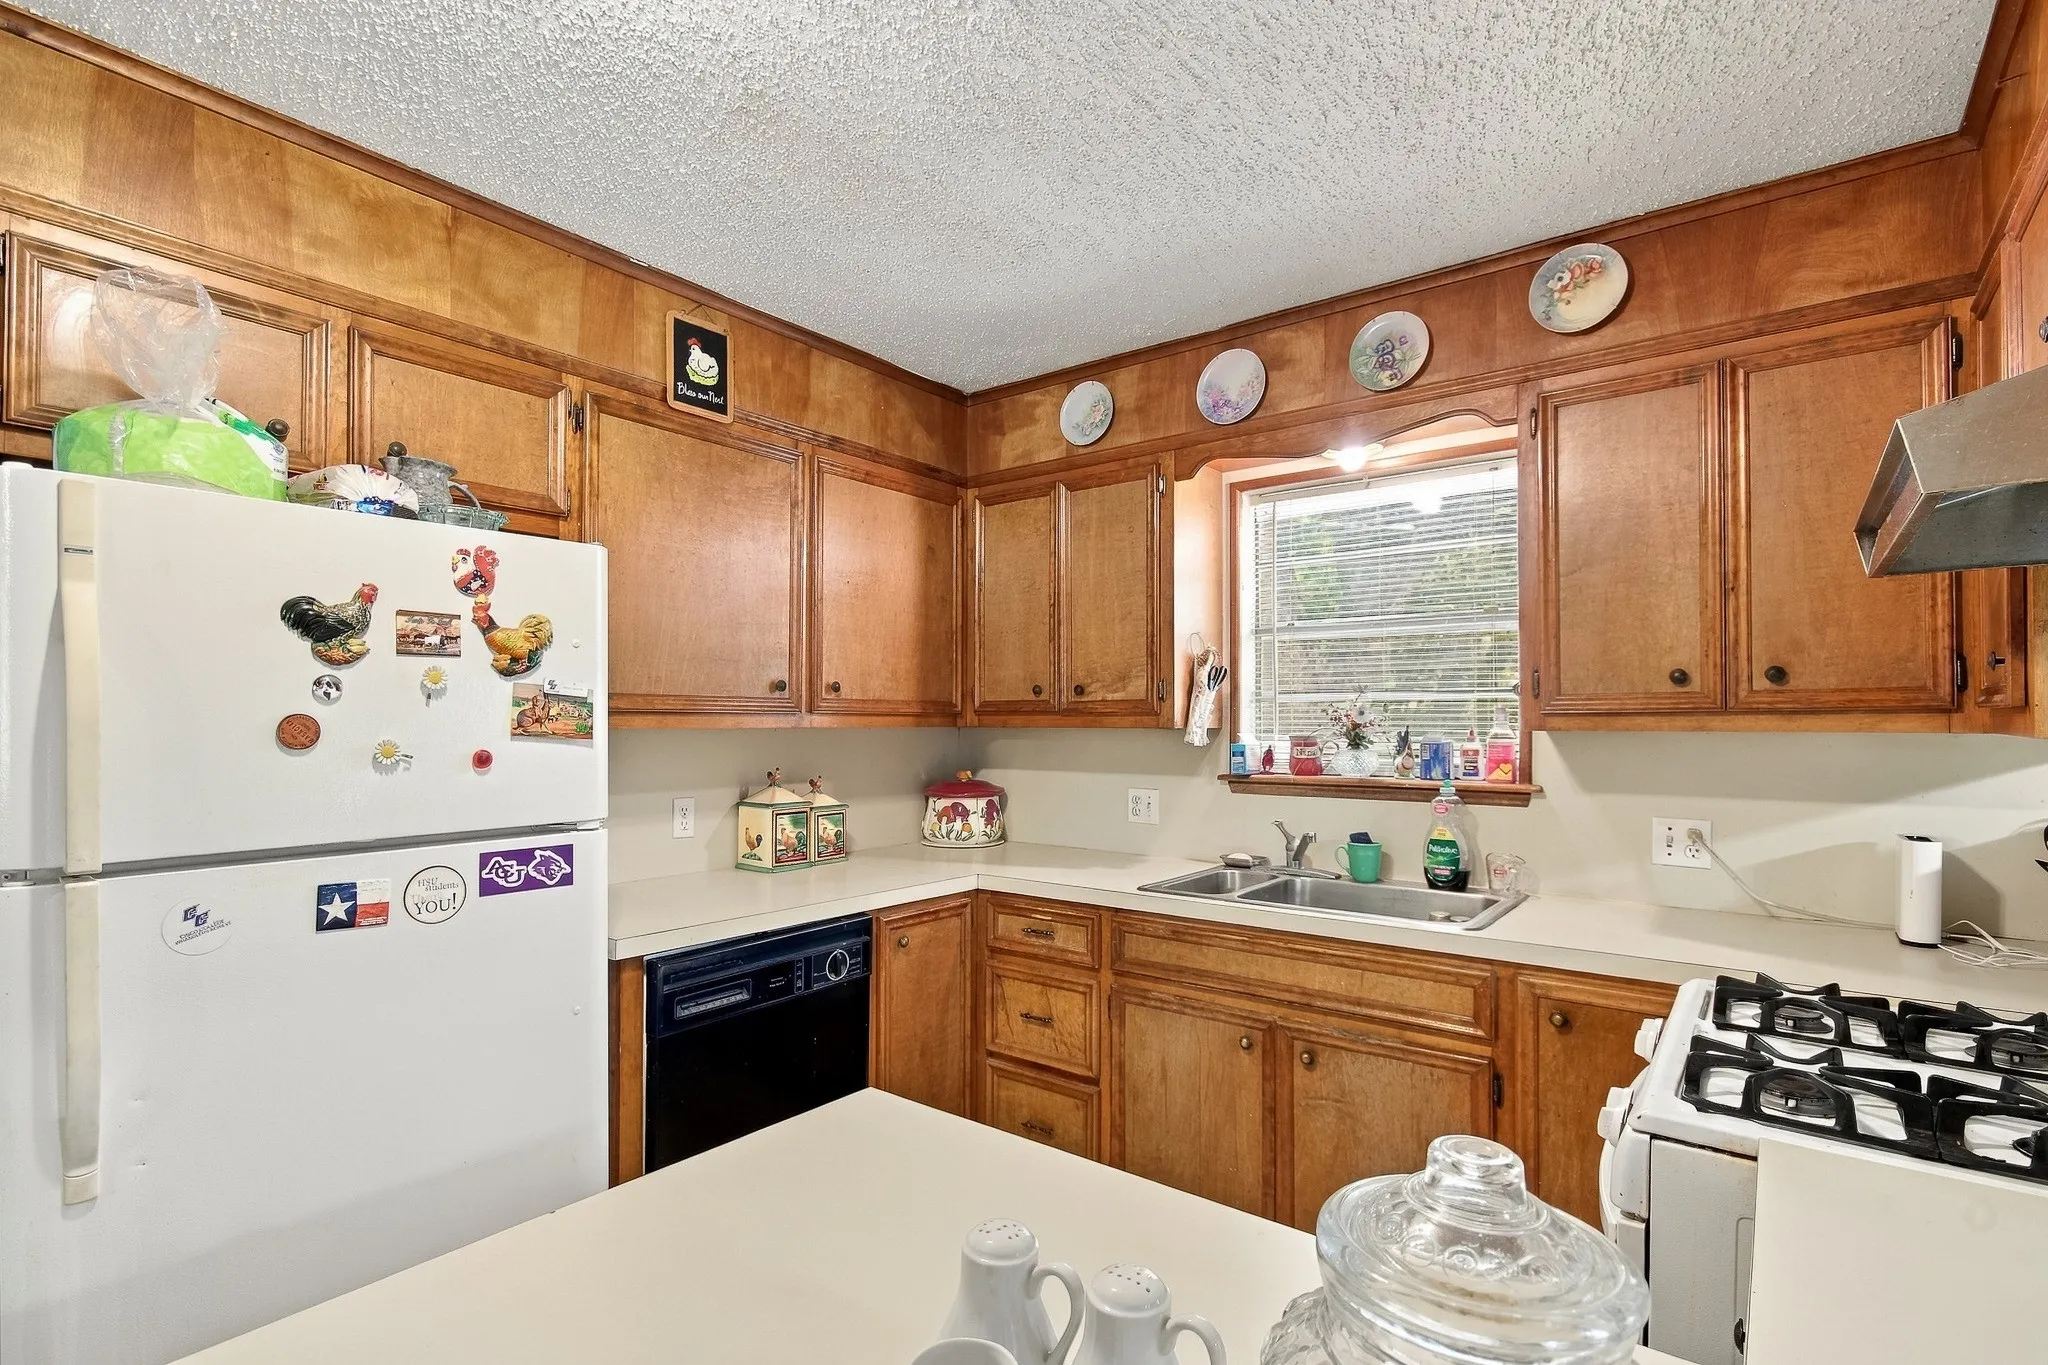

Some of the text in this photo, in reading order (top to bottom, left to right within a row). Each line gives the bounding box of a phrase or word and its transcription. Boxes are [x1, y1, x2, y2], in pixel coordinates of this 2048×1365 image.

[677, 381, 724, 405] Bless our Nest
[424, 882, 459, 892] students
[414, 893, 457, 915] YOU!
